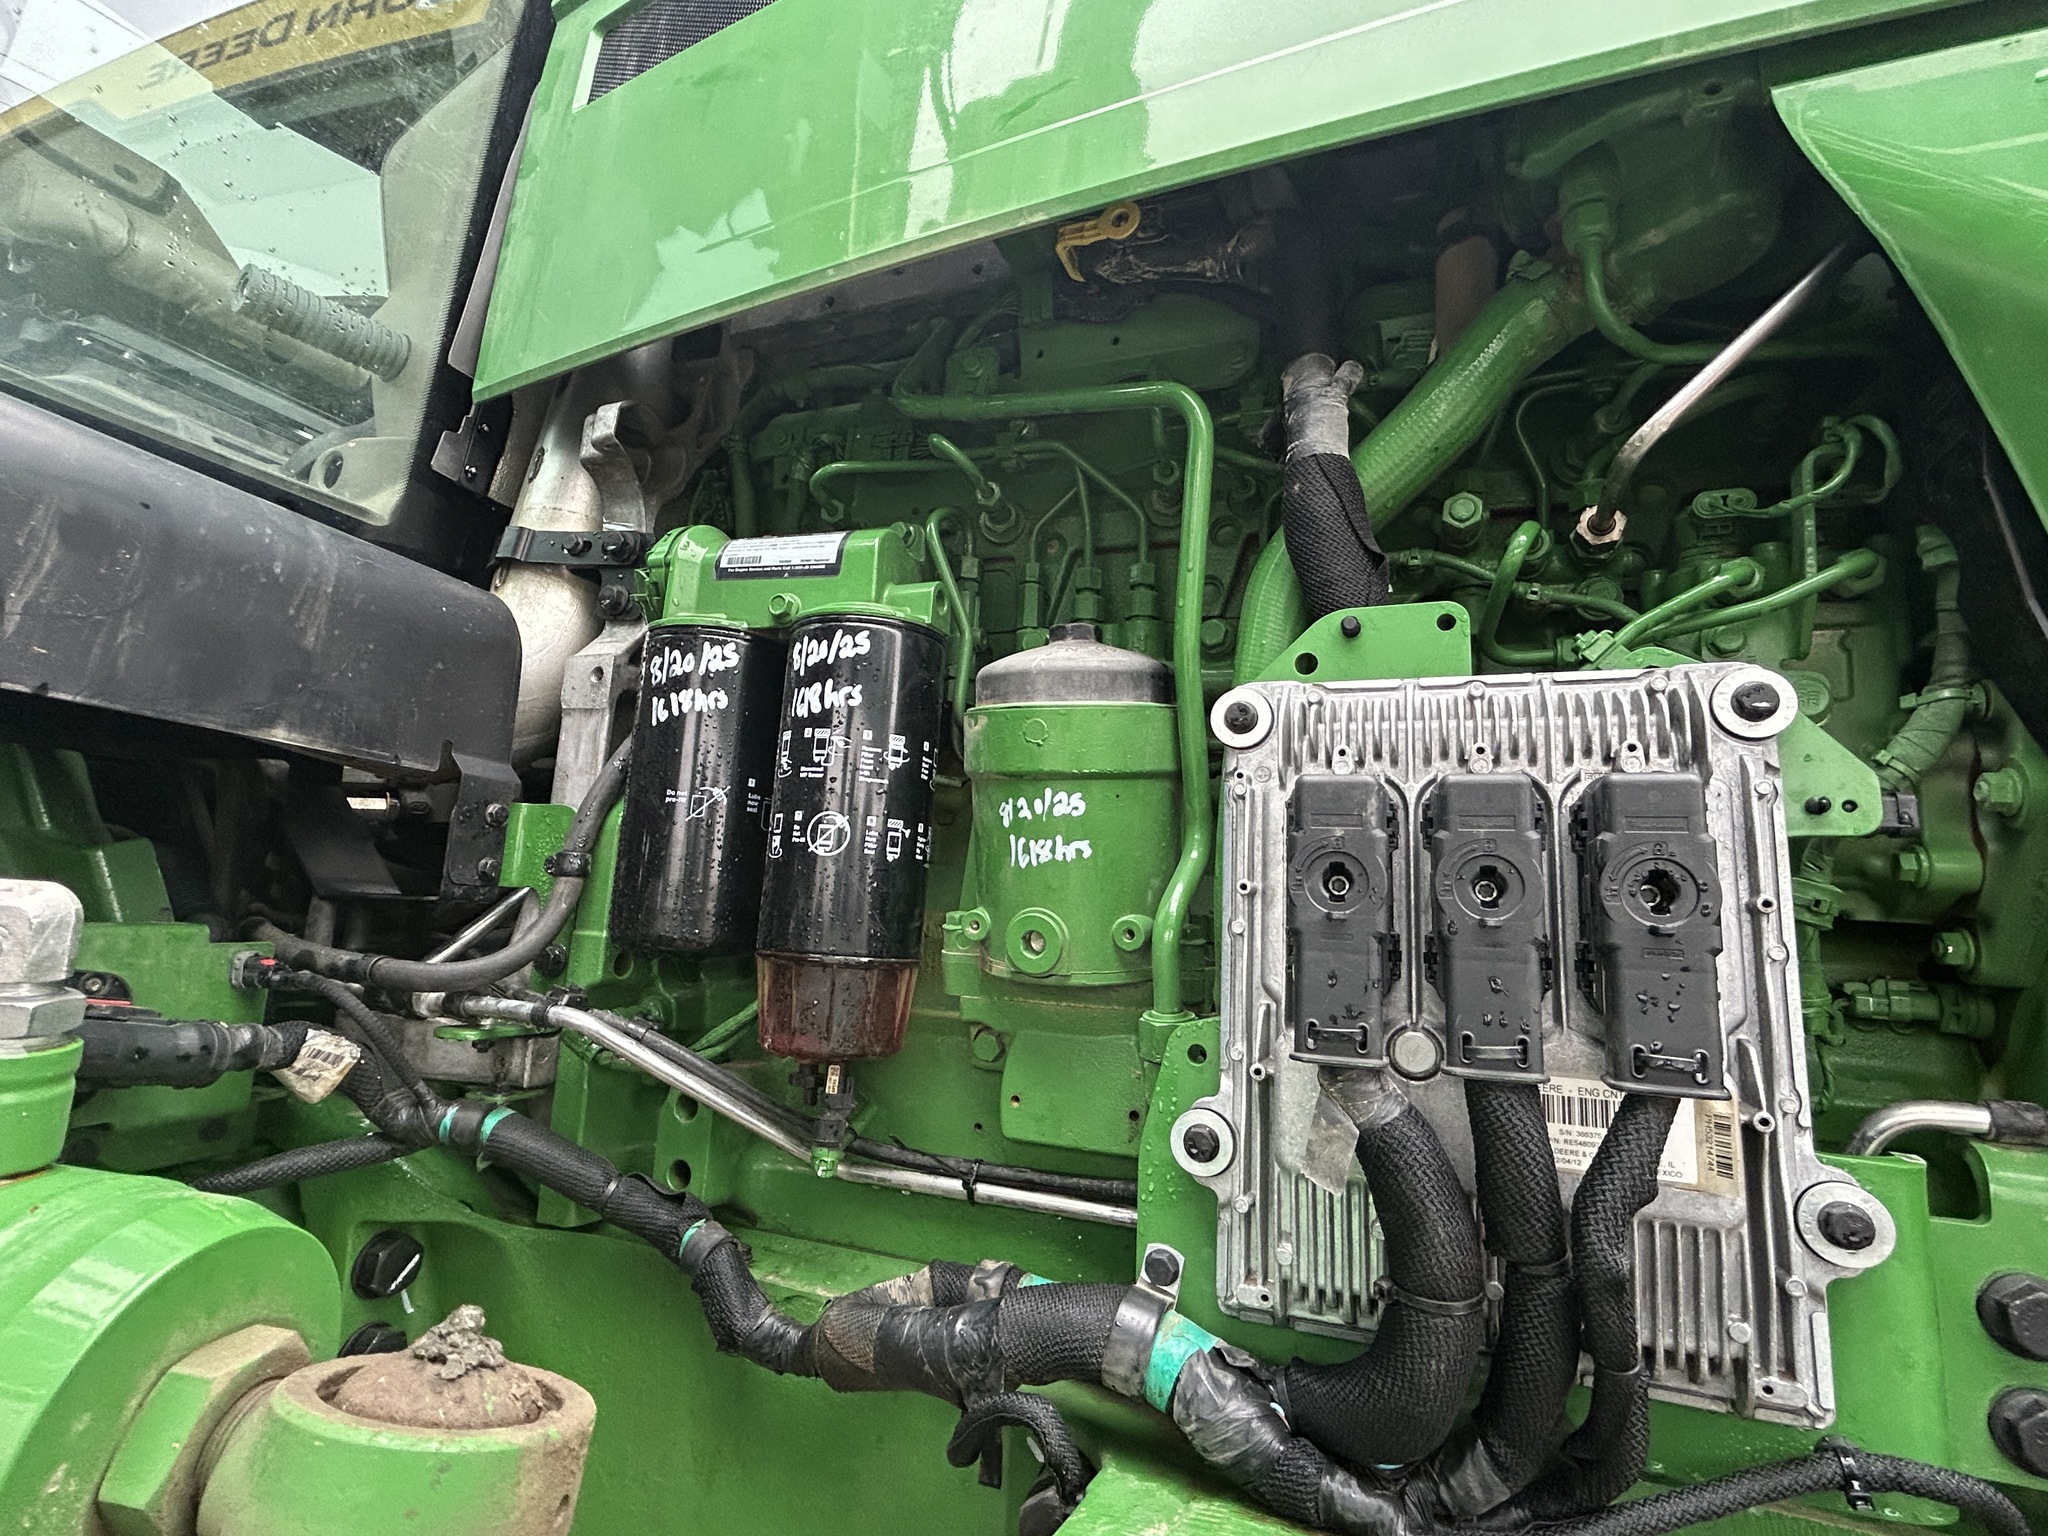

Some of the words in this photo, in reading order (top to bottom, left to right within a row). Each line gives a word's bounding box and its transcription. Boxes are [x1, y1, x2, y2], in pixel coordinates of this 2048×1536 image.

[1577, 1086, 1600, 1098] ENG
[1554, 1148, 1581, 1158] DEERE
[1555, 1157, 1583, 1166] 2/04/12
[1657, 1168, 1684, 1179] EXICO
